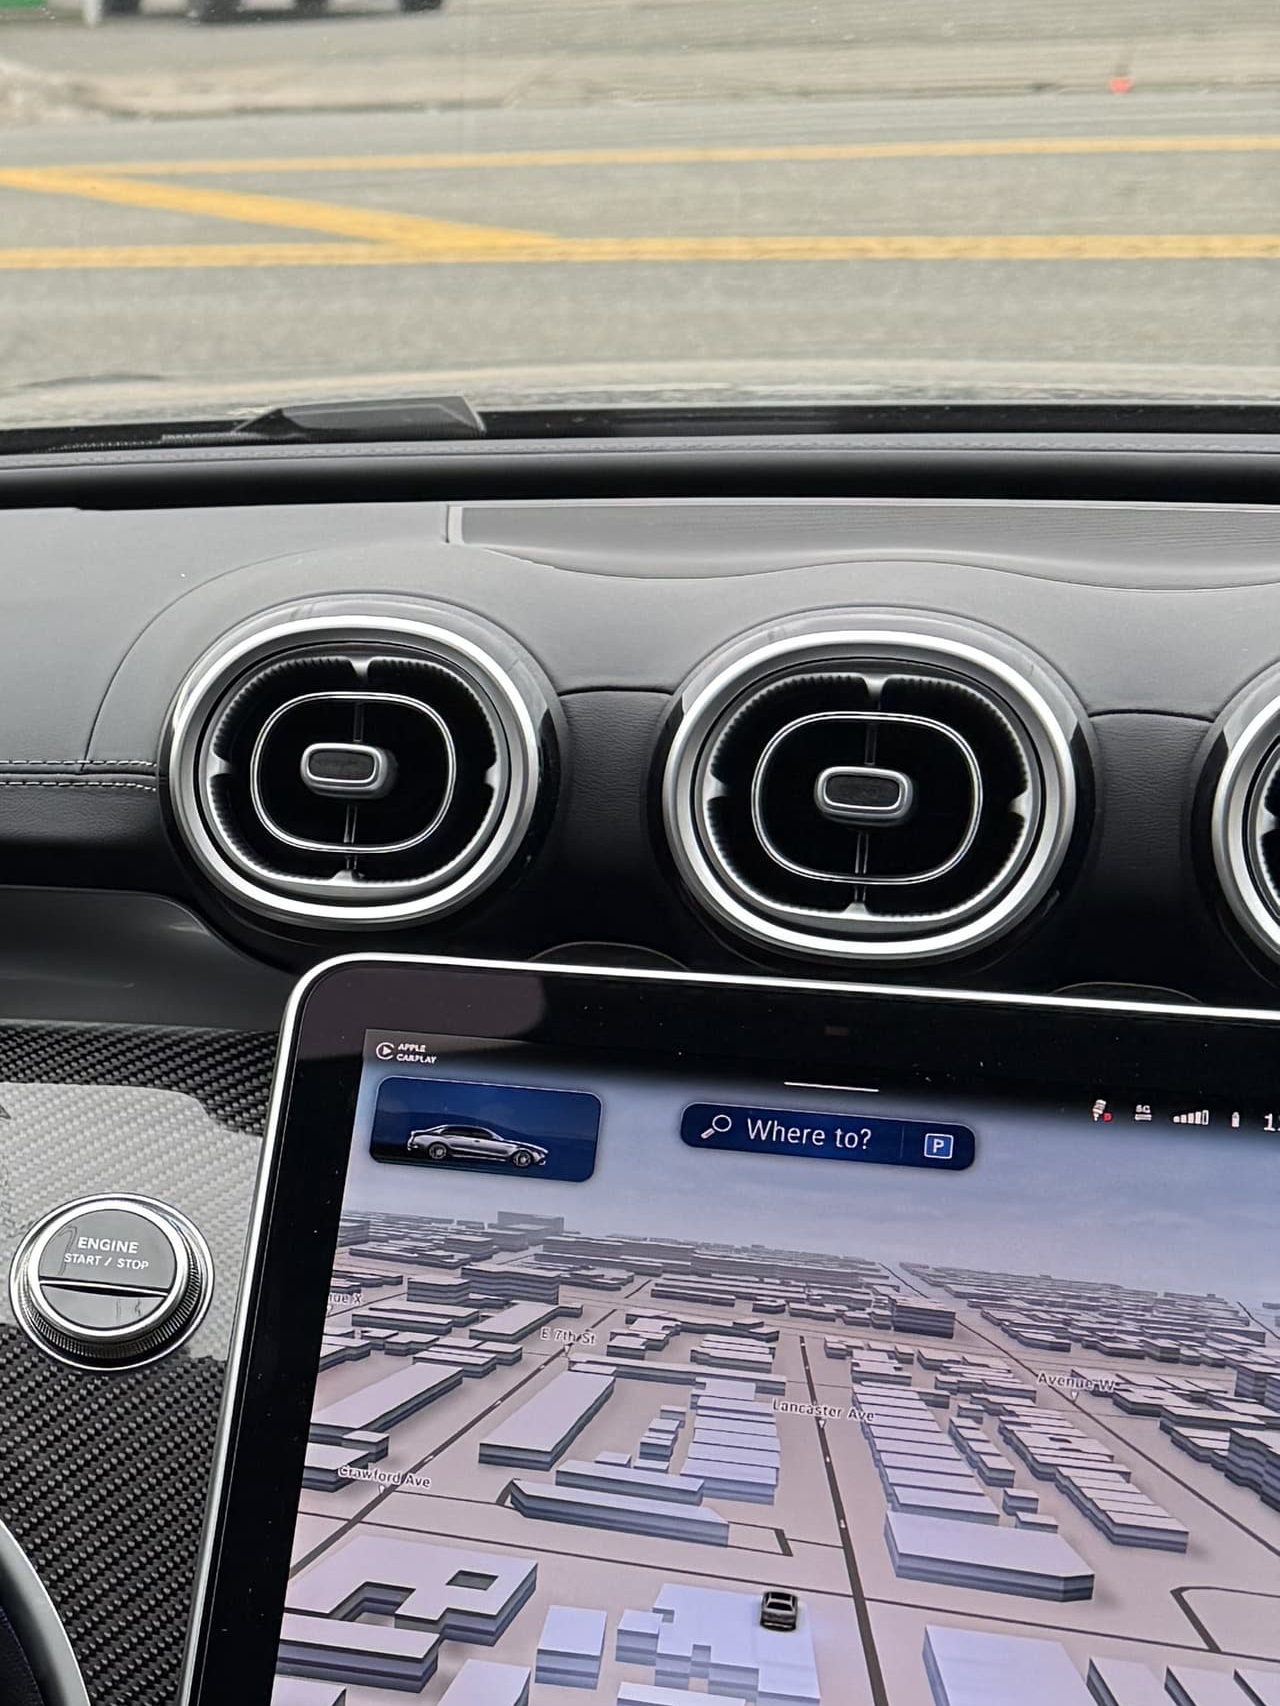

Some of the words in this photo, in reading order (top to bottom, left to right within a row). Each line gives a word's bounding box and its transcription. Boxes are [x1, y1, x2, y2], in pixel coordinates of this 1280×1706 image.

[397, 1043, 426, 1053] APPLE
[396, 1053, 438, 1064] CARPLAY
[747, 1118, 826, 1146] Where
[834, 1128, 872, 1150] to?
[77, 1236, 140, 1254] ENGINE
[63, 1253, 102, 1266] START
[116, 1258, 149, 1270] STOP
[540, 1328, 548, 1340] E
[1038, 1372, 1094, 1390] Avenue
[772, 1398, 843, 1418] Lancaster
[848, 1407, 875, 1422] Ave
[339, 1465, 401, 1485] Crawford
[405, 1474, 431, 1488] Ave
